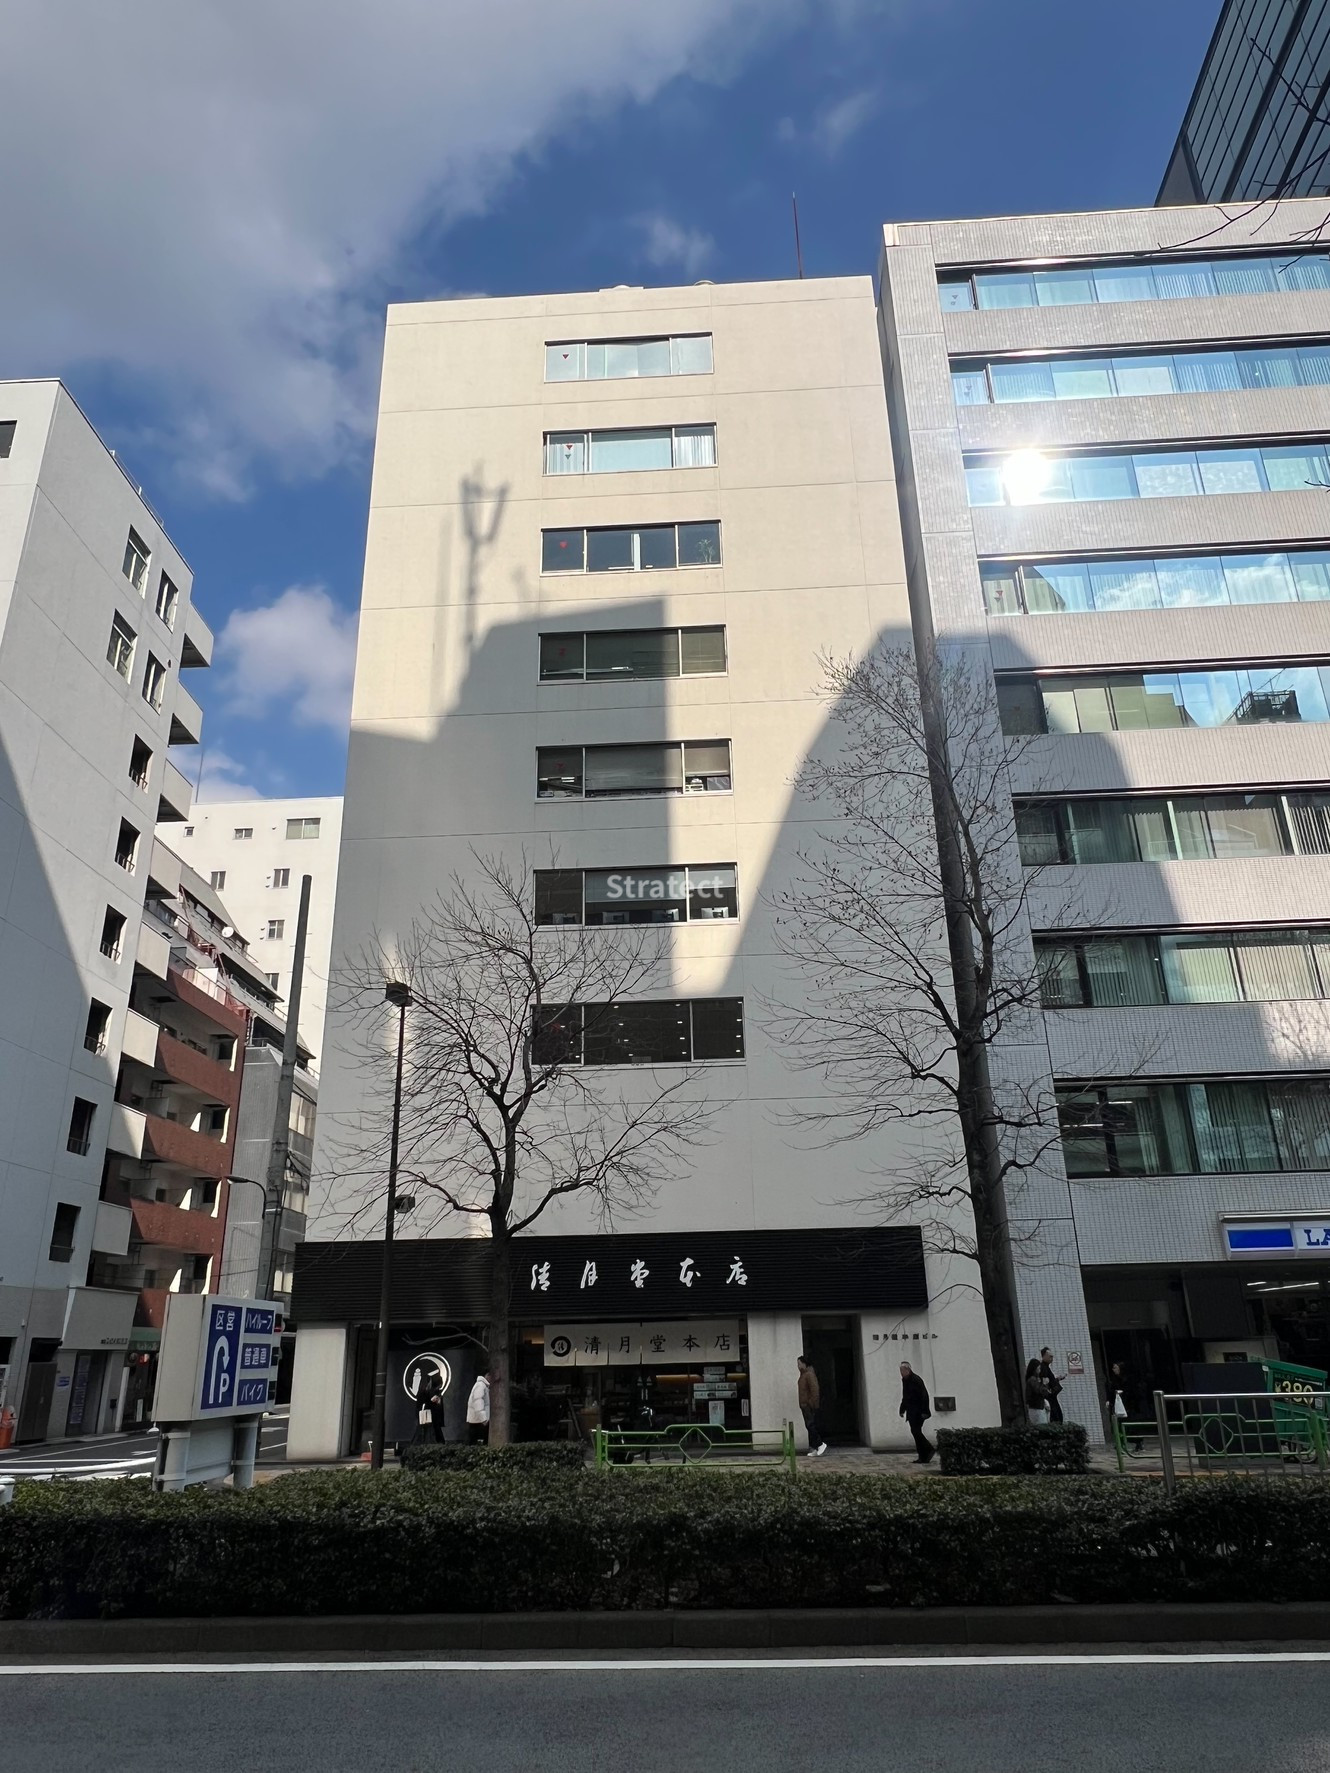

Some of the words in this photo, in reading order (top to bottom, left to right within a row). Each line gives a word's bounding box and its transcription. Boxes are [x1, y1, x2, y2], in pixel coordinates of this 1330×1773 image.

[530, 1256, 748, 1291] 清月堂本店
[245, 1312, 273, 1330] ハイルーフ
[584, 1334, 731, 1355] 清月堂本店
[219, 1373, 230, 1404] P
[240, 1383, 264, 1402] バイク
